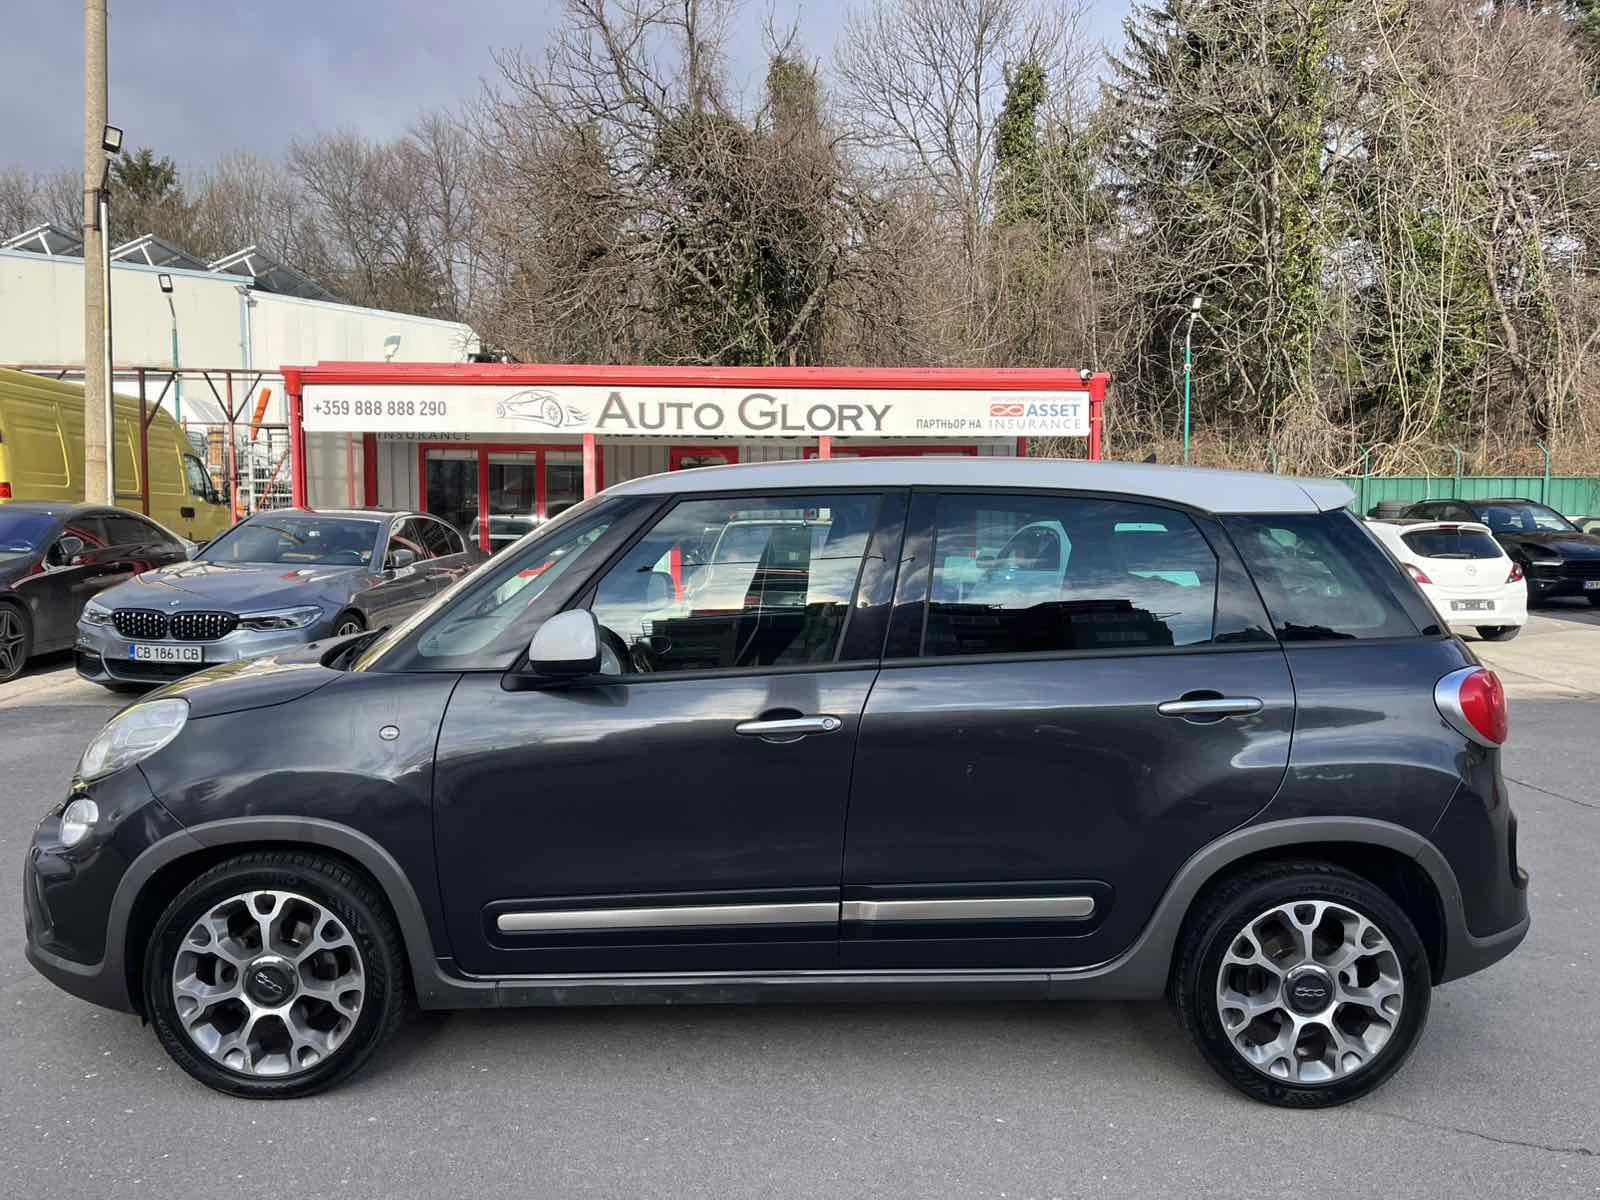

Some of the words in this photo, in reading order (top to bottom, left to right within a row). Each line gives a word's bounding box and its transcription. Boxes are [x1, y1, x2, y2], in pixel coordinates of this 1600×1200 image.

[313, 400, 350, 416] +359
[354, 400, 383, 416] 888
[387, 400, 415, 416] 888
[419, 400, 447, 416] 290
[1026, 403, 1081, 417] ASSET
[916, 418, 965, 429] ПАРТНЬОР
[968, 418, 982, 429] НА
[988, 419, 1081, 430] INSURANCE
[136, 647, 151, 659] CB
[154, 648, 181, 660] 1861
[183, 648, 199, 660] CB
